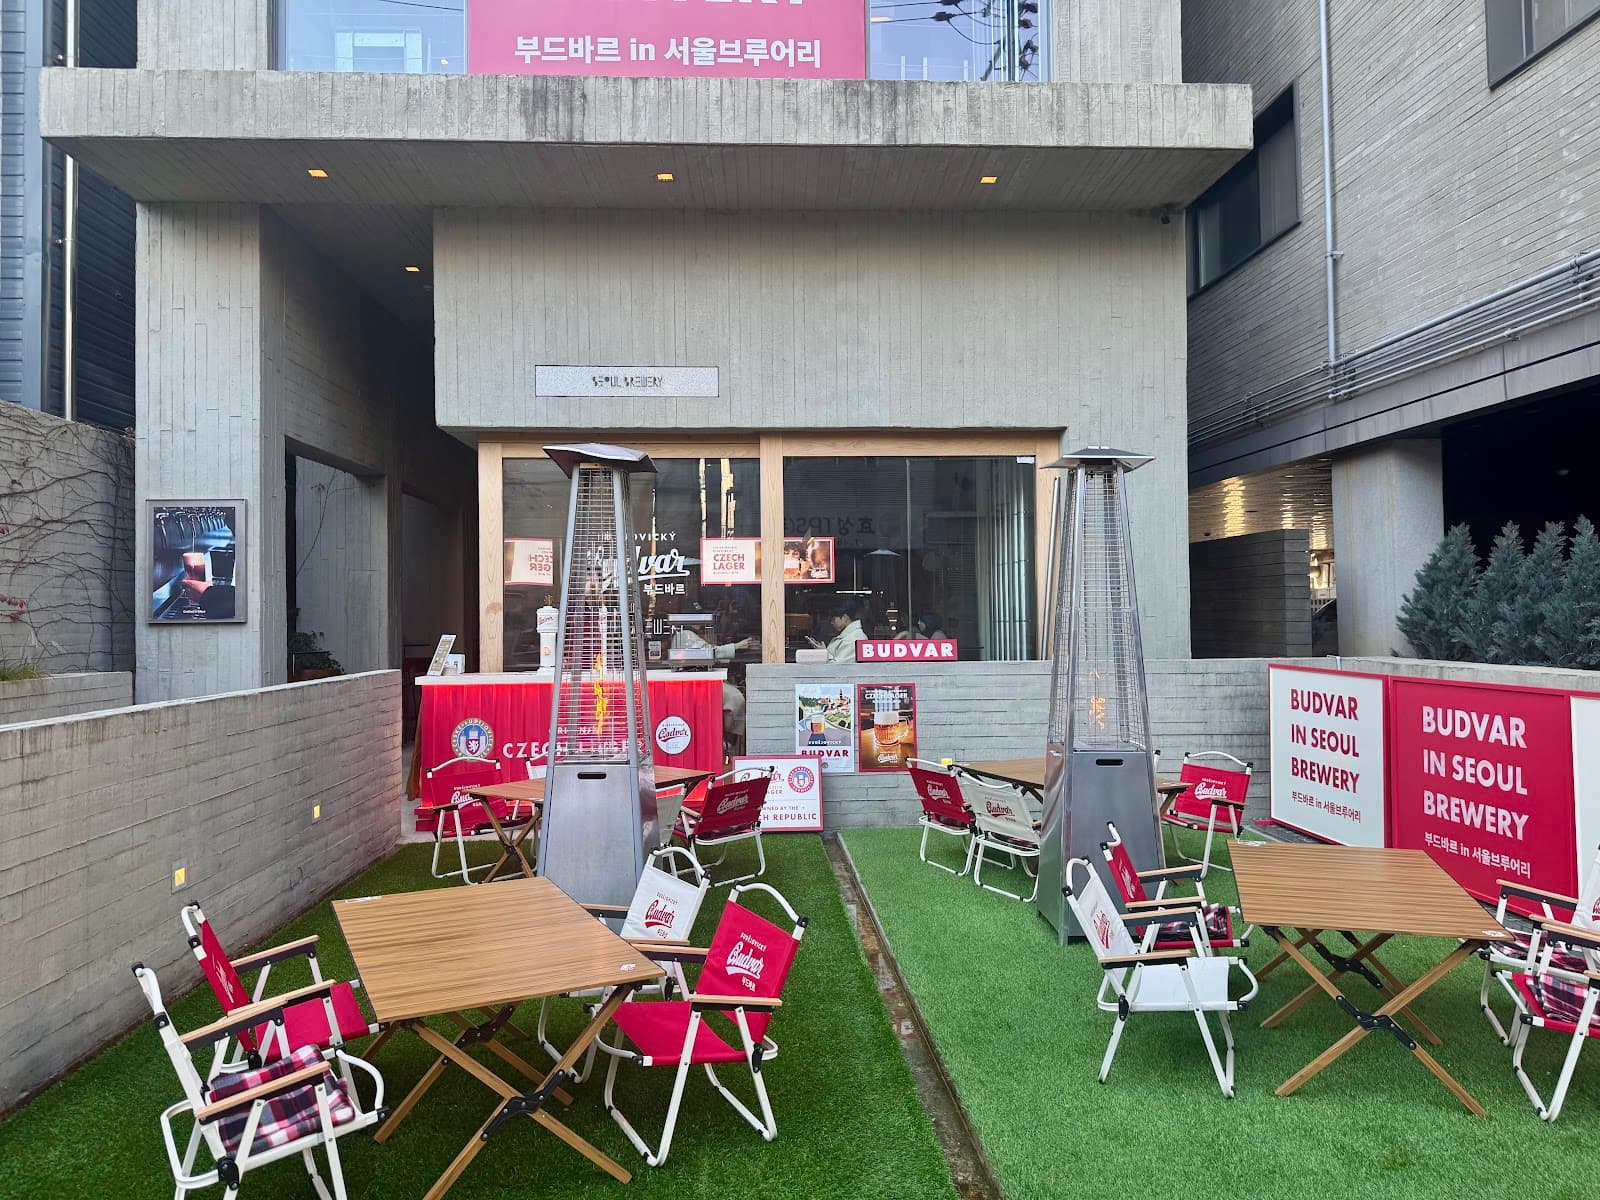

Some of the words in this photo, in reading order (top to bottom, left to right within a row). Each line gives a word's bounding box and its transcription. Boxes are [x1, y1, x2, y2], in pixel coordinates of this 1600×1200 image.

[514, 35, 622, 64] 부드바르
[629, 37, 656, 61] in
[663, 36, 821, 68] 서울브루어리
[592, 376, 620, 388] SEOUL
[713, 553, 745, 562] CZECH
[713, 562, 745, 570] LAGER
[643, 583, 685, 595] 부드바르
[862, 643, 954, 658] BUDVAR
[1290, 688, 1359, 720] BUDVAR
[1291, 723, 1306, 745] IN
[1311, 727, 1360, 758] SEOUL
[1422, 705, 1528, 749] BUDVAR
[1291, 756, 1360, 793] BREWERY
[1423, 749, 1446, 778] IN
[1452, 754, 1528, 795] SEOUL
[1194, 782, 1228, 800] Budvar
[1292, 791, 1314, 806] 부드바르
[1315, 798, 1322, 809] in
[1323, 800, 1361, 823] 서울브루어리
[773, 813, 817, 821] REPUBLIC
[986, 801, 1015, 817] Budvar
[1423, 789, 1529, 841] BREWERY
[1424, 831, 1459, 854] 부드바르
[1460, 843, 1470, 858] in
[1471, 846, 1531, 879] 서울브루어리
[645, 899, 675, 928] Budvar
[725, 941, 765, 980] Budvar
